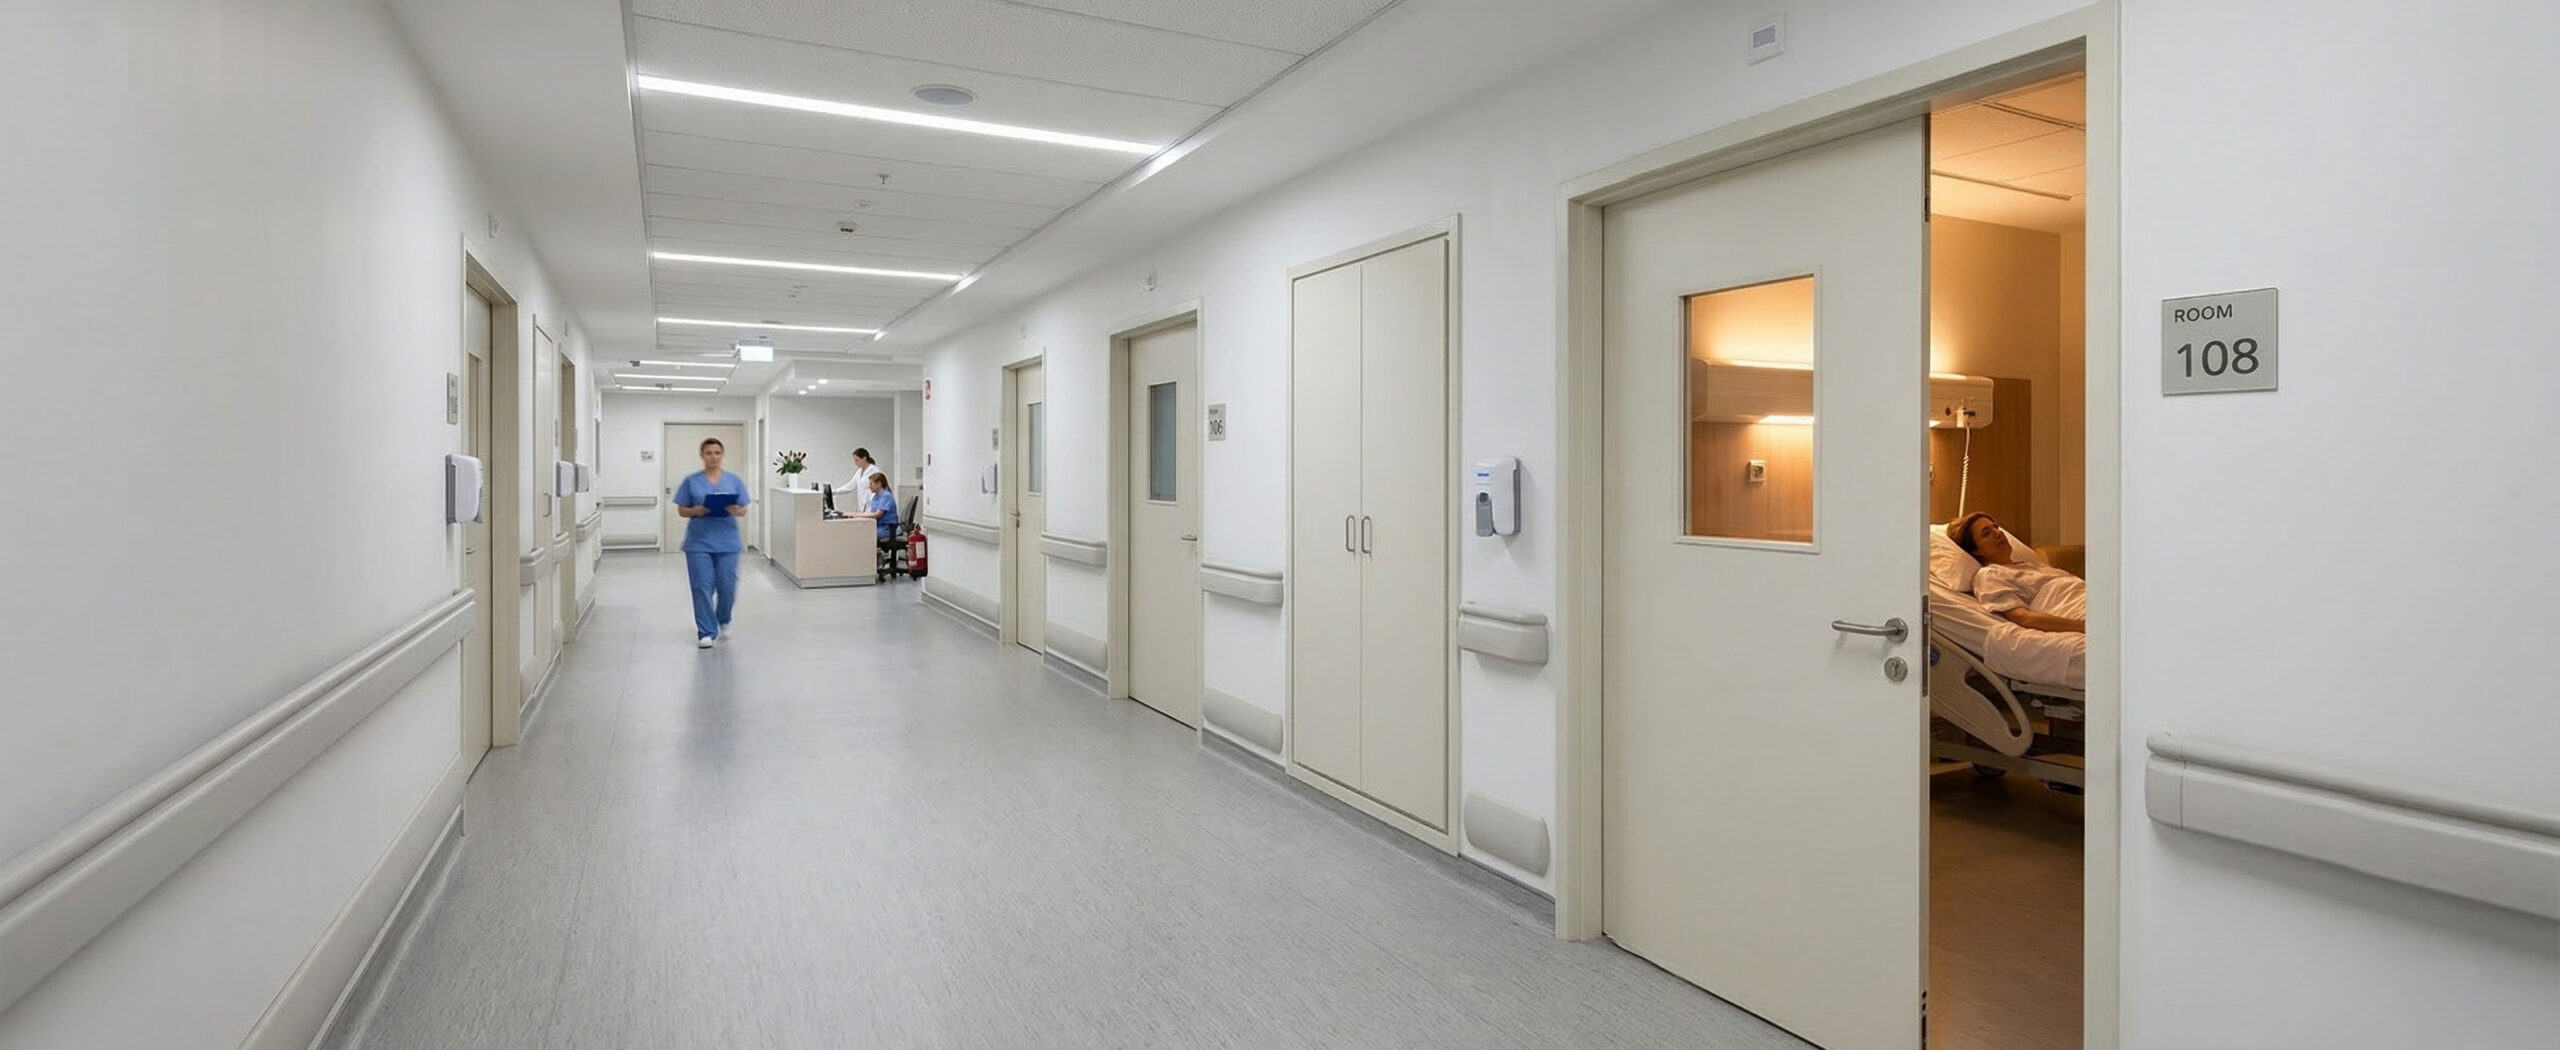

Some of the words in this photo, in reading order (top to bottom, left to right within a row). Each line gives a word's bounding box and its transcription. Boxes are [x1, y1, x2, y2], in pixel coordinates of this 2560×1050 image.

[2174, 303, 2233, 323] ROOM
[2177, 337, 2259, 378] 108
[1209, 419, 1224, 435] 106
